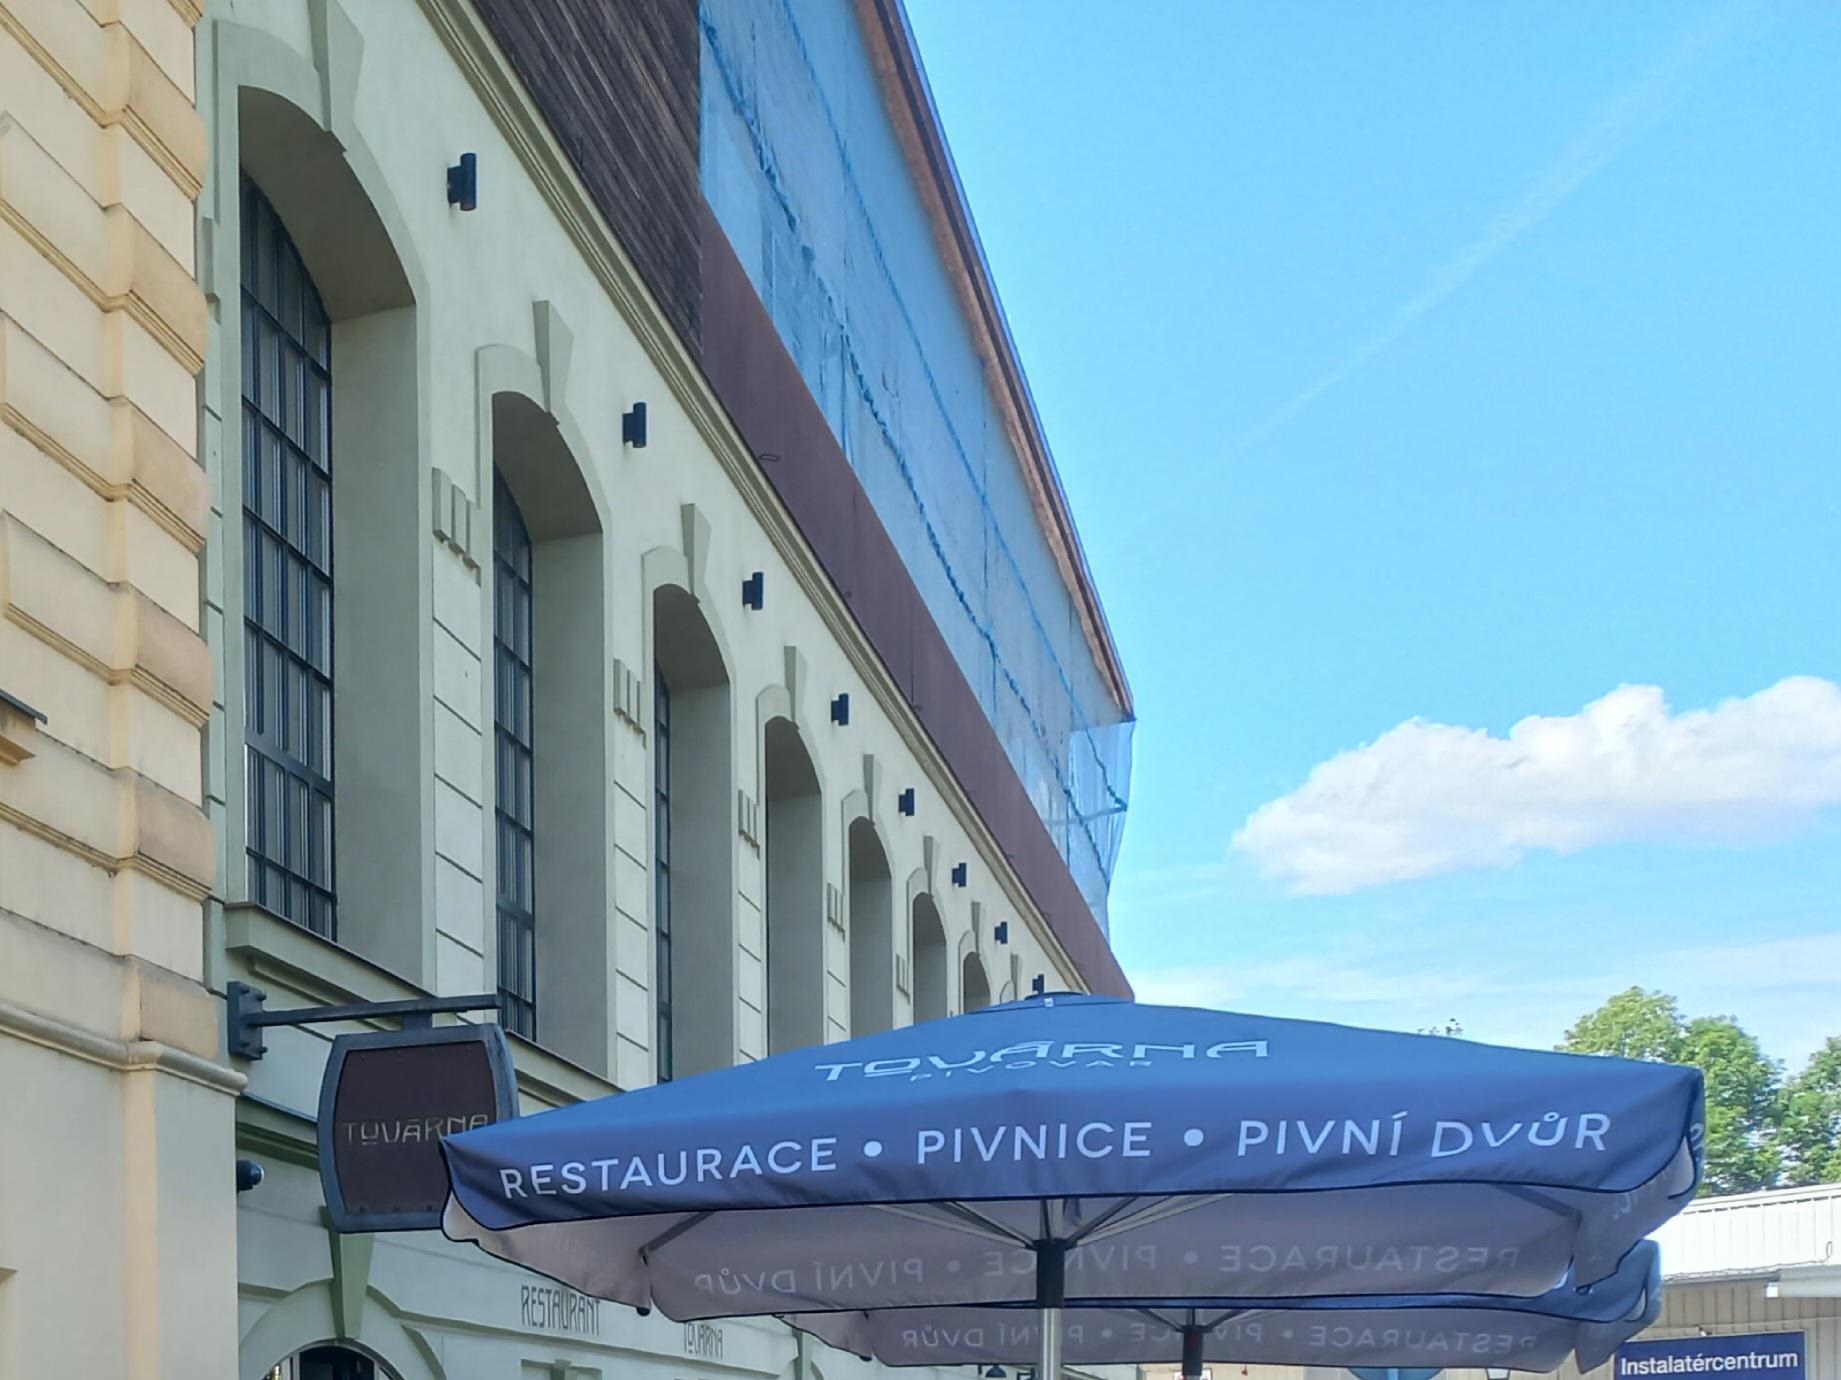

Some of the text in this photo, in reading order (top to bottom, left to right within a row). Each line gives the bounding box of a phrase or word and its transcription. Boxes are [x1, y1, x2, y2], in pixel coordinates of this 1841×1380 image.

[499, 1111, 1611, 1199] RESTAURACE PIVNICE PIVNÍ DVŮR
[521, 1285, 601, 1336] RESTAURANT
[1621, 1352, 1798, 1376] Instalatércentrum
